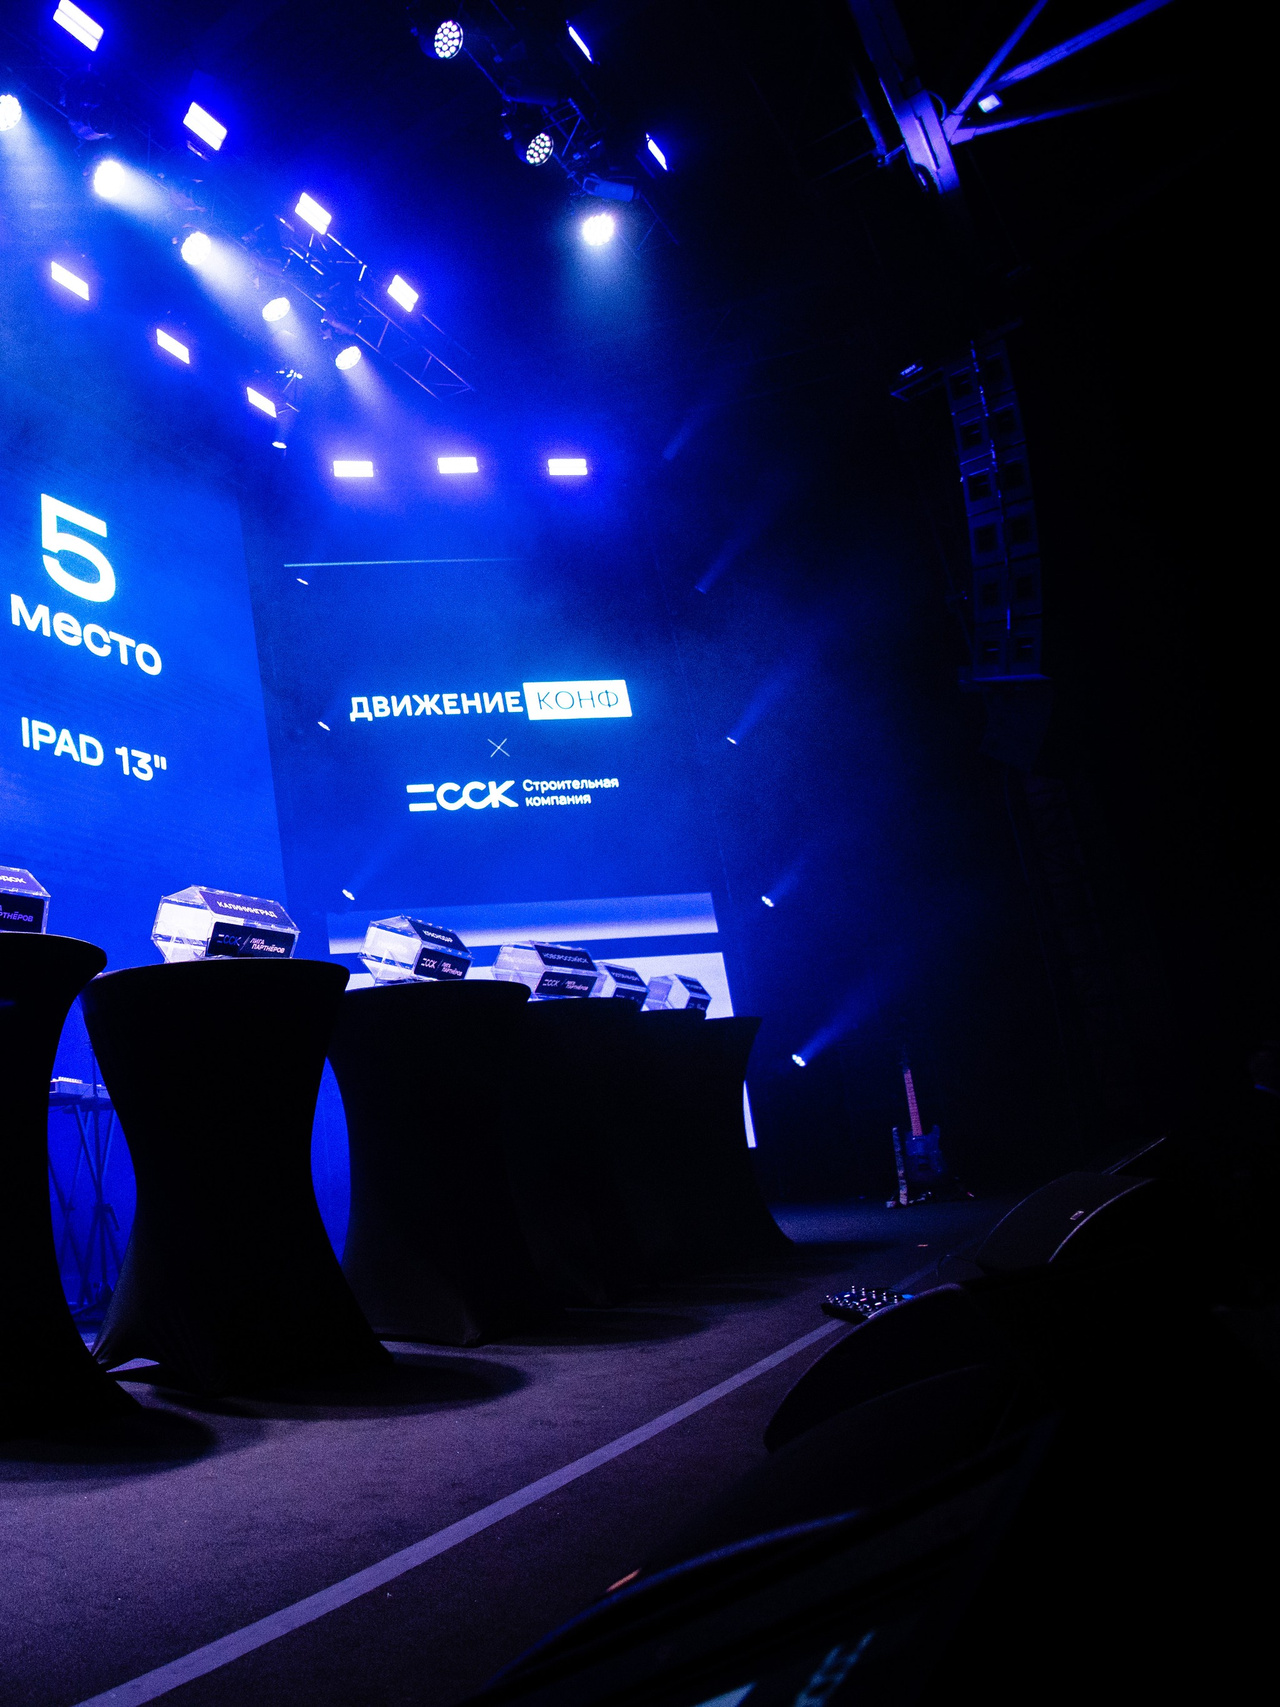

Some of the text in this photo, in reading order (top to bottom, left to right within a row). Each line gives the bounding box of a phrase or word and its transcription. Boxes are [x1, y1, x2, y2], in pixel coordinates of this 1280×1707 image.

[41, 493, 116, 602] 5
[349, 689, 619, 722] ДВИЖЕНИЕ КОНФ
[21, 716, 167, 781] IPAD 13"
[522, 777, 620, 793] Строительная
[525, 794, 592, 808] компания
[216, 900, 279, 919] КАЛИНИНГРАД
